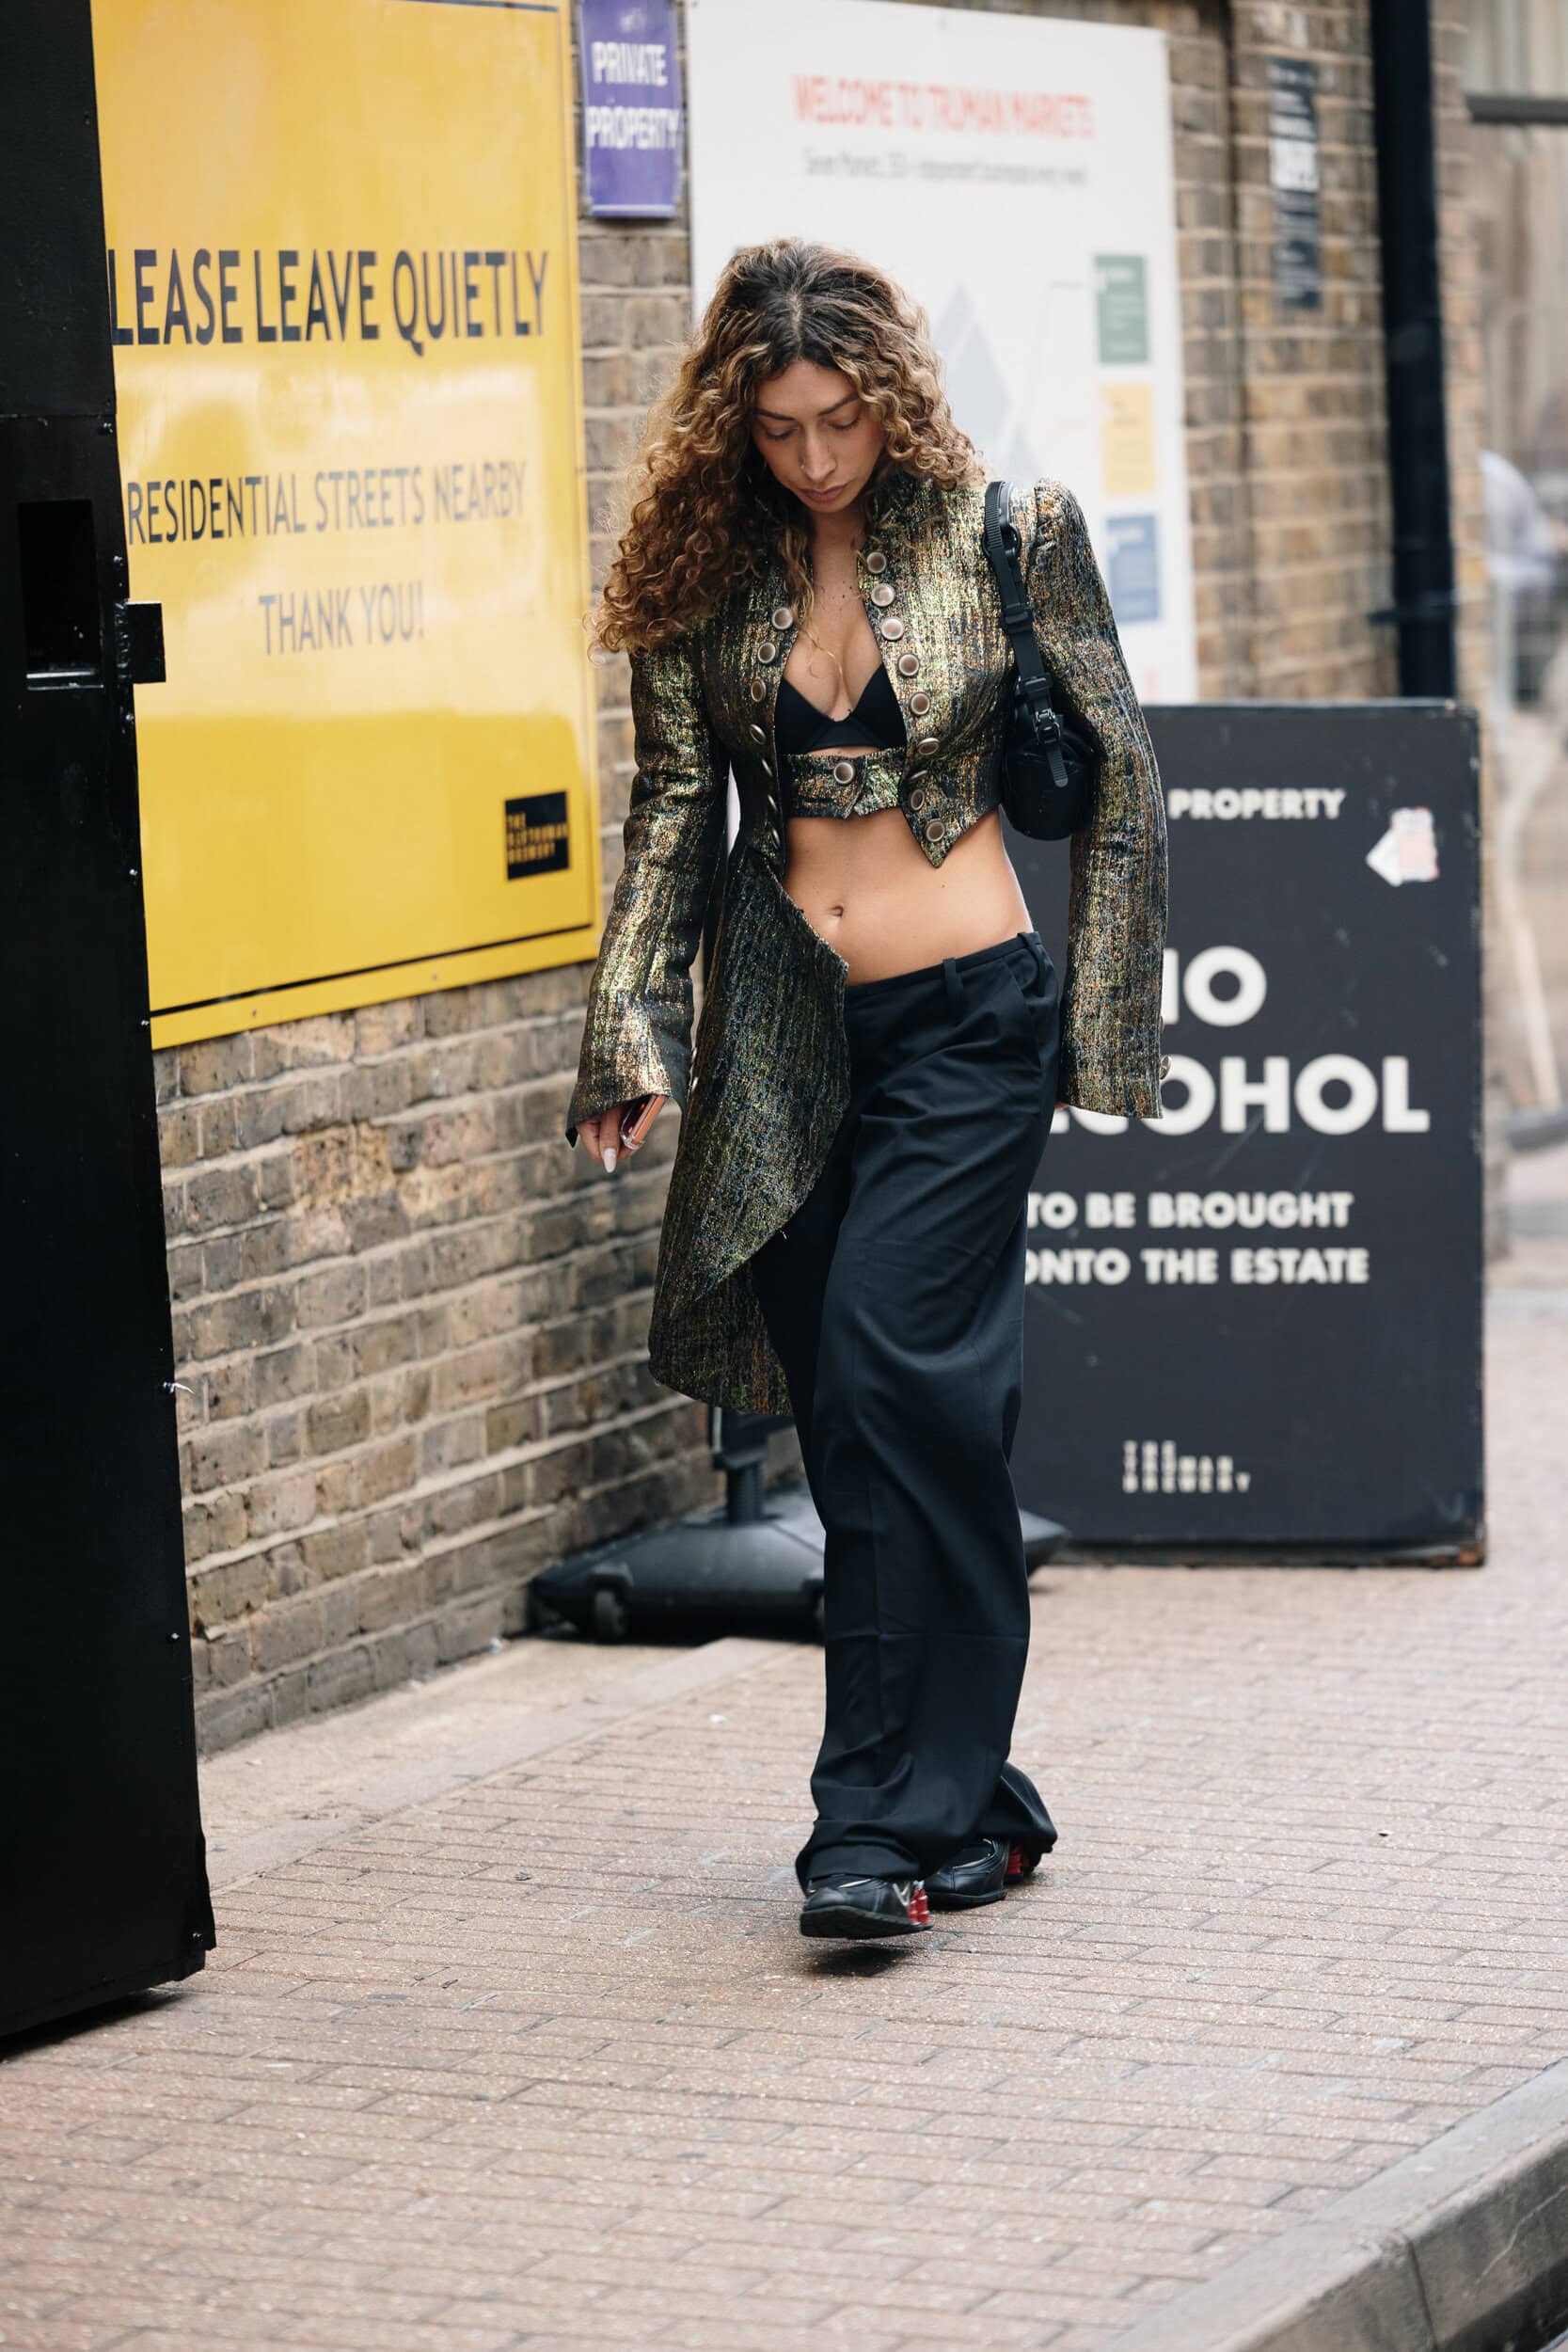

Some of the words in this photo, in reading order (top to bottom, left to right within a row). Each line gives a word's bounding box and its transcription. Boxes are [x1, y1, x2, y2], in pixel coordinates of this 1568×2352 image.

[592, 41, 668, 87] PRIVATE
[585, 105, 679, 149] PROPERTY
[108, 248, 244, 346] LEASE
[254, 249, 381, 342] LEAVE
[392, 249, 548, 358] QUIETLY
[127, 474, 307, 545] RESIDENTIAL
[313, 467, 425, 532] STREETS
[434, 460, 526, 522] NEARBY
[260, 588, 354, 656] THANK
[359, 579, 424, 644] YOU!
[1168, 789, 1345, 819] PROPERTY
[1161, 946, 1267, 1026] O
[1049, 1053, 1430, 1136] OHOL
[1085, 1192, 1135, 1229] BE
[1148, 1192, 1354, 1229] BROUGHT
[1140, 1248, 1217, 1284] THE
[1230, 1248, 1370, 1285] ESTATE
